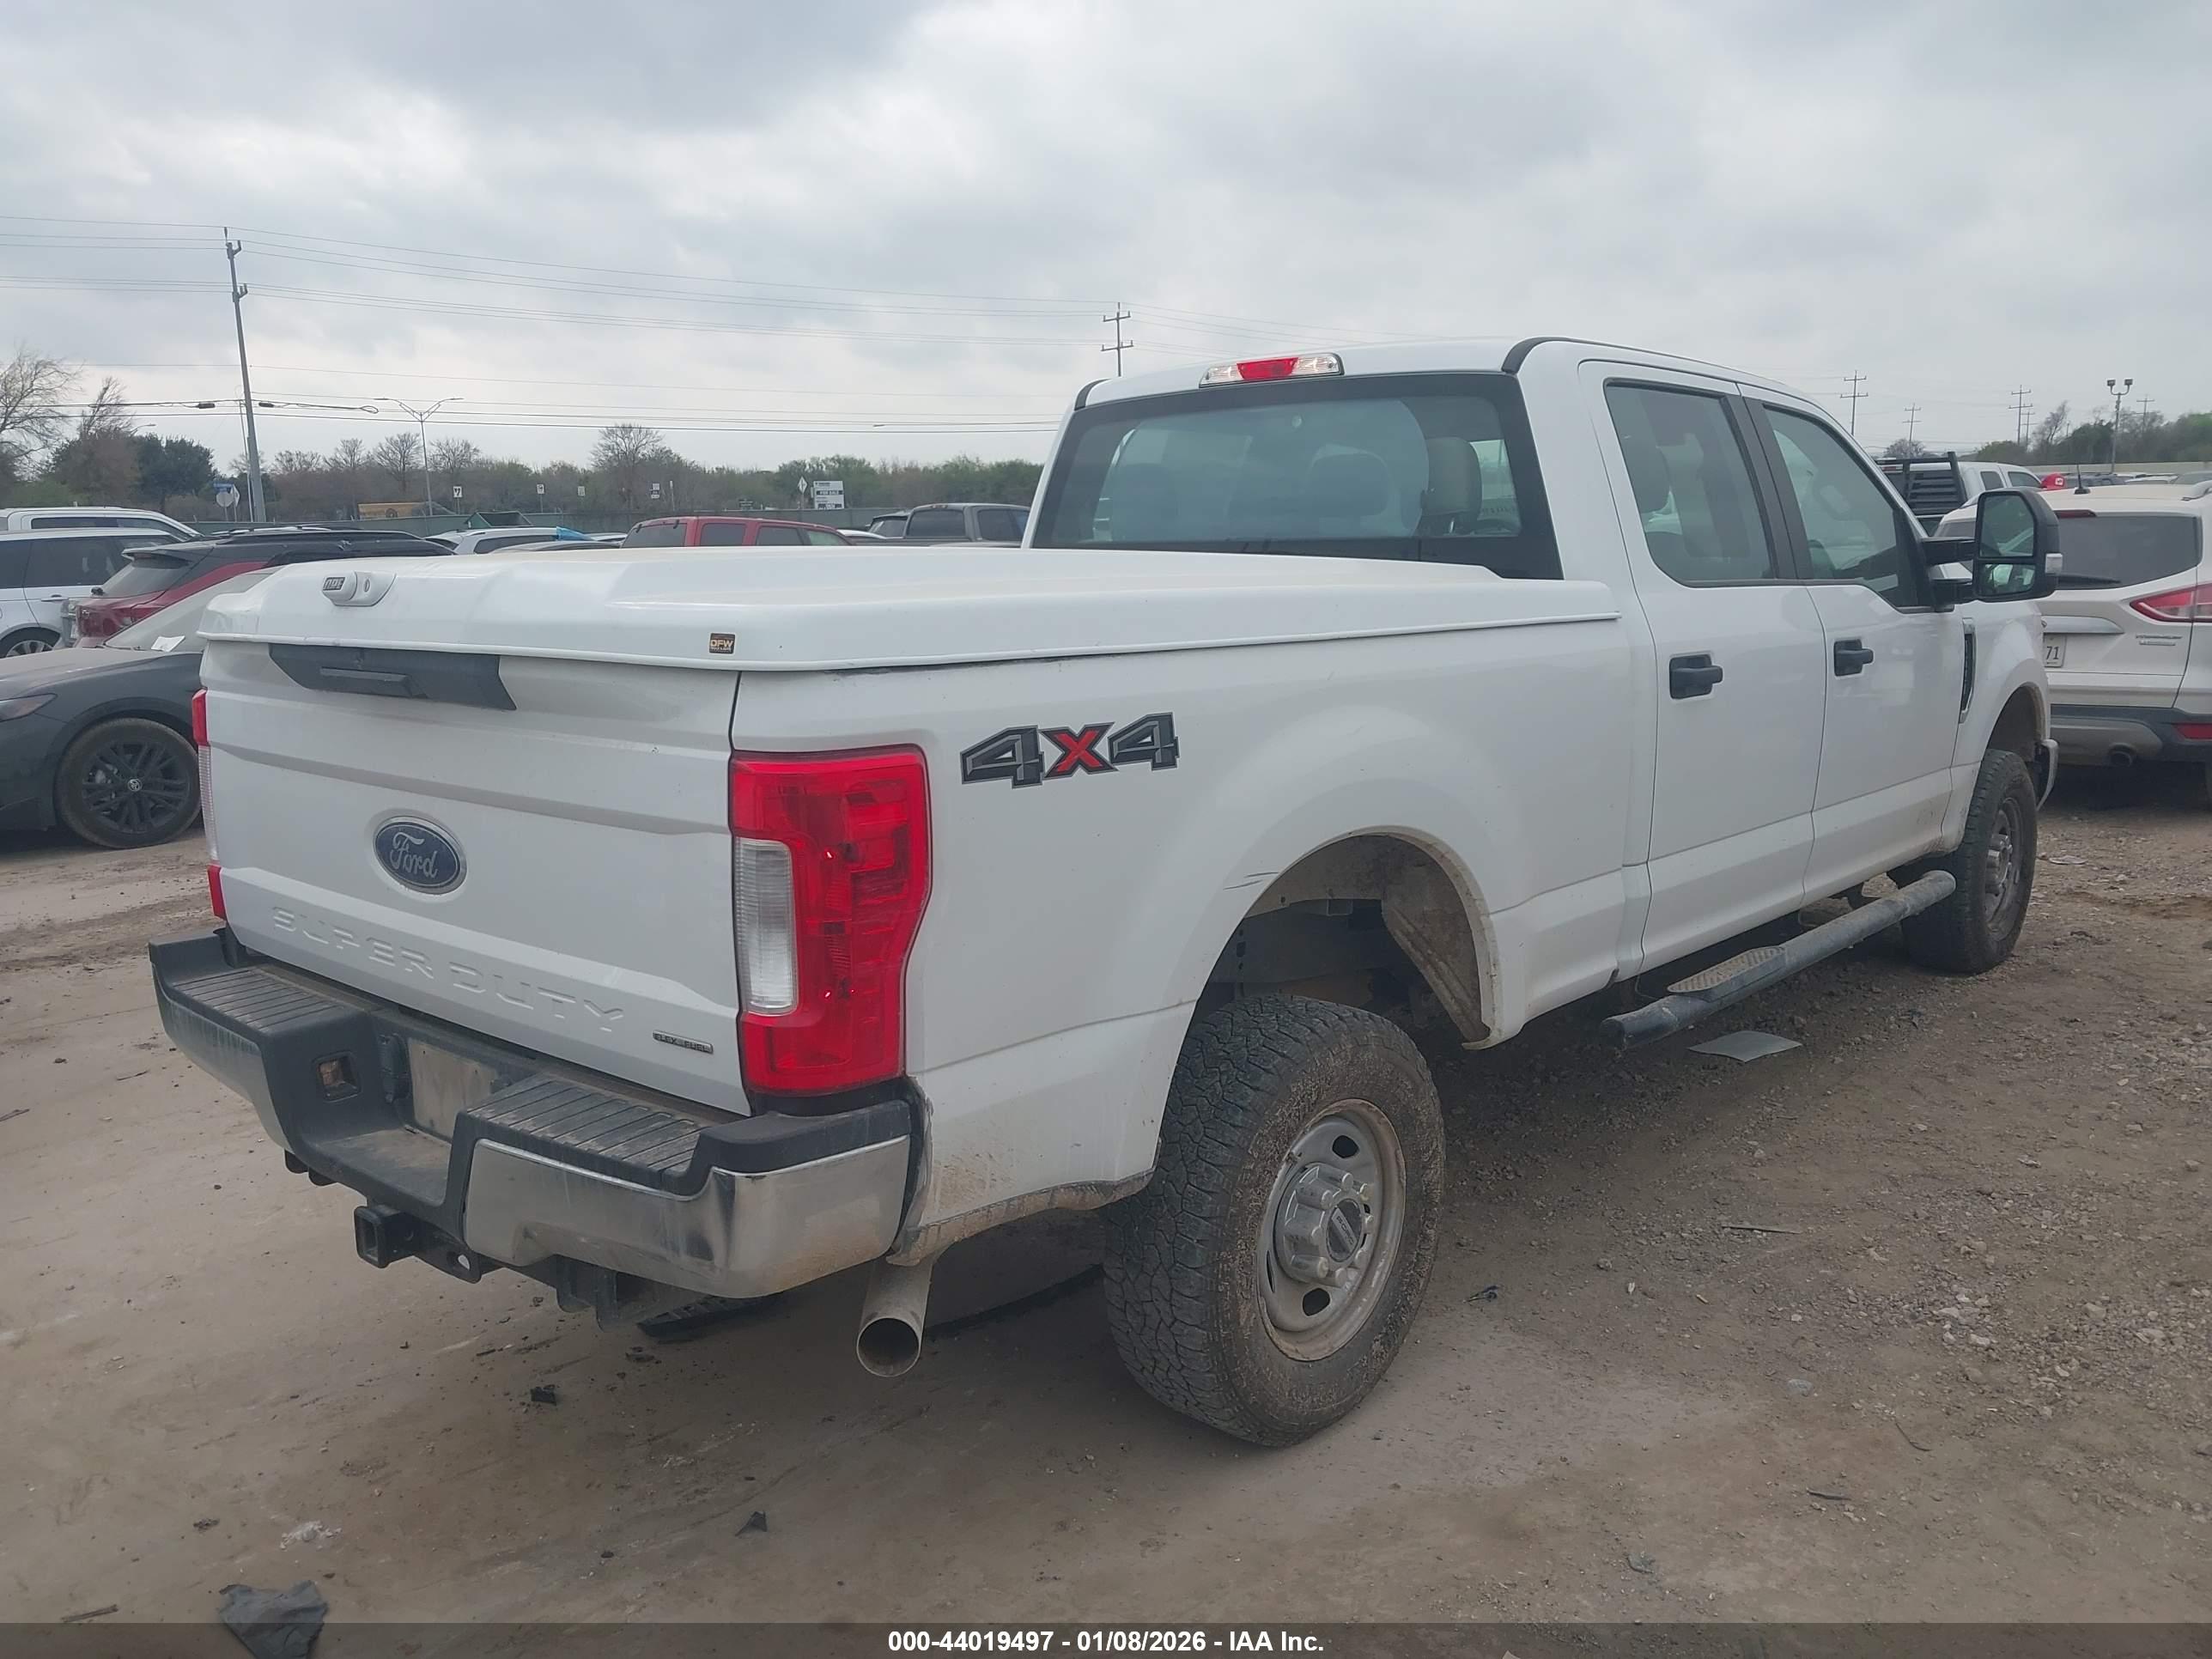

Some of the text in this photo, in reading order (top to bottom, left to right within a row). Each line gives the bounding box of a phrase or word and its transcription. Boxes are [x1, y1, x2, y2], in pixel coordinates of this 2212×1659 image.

[2046, 646, 2059, 660] 71
[390, 830, 439, 878] Ford
[272, 906, 624, 1032] SUPER DUTY
